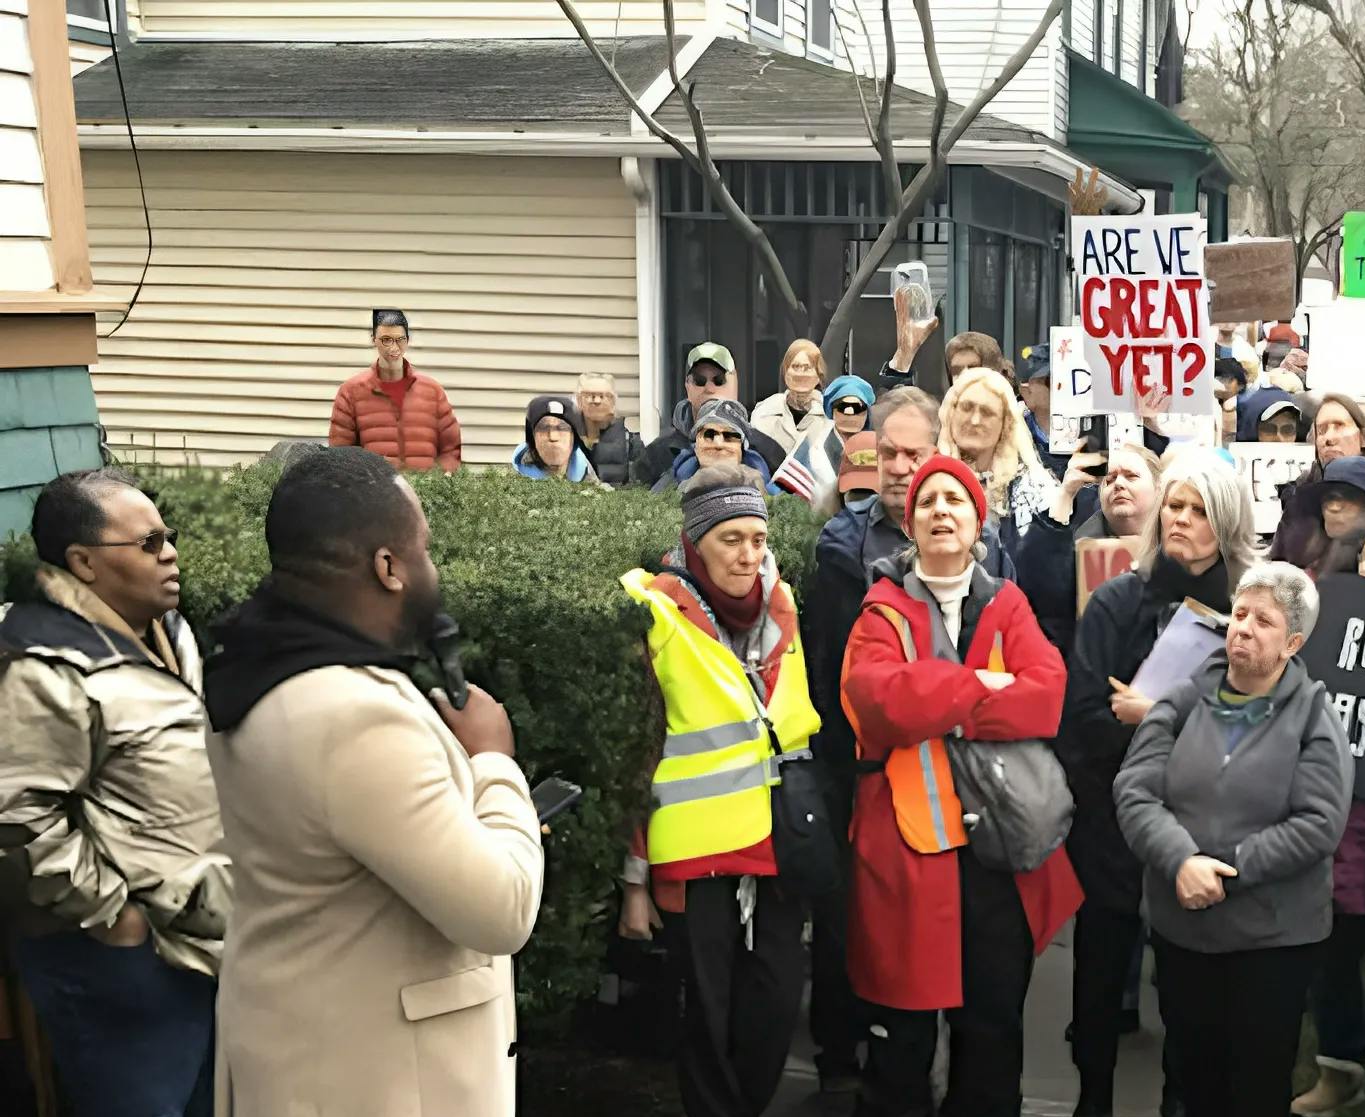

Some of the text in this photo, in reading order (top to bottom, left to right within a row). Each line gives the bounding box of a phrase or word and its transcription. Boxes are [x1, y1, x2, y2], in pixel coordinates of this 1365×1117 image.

[1083, 228, 1146, 275] ARE
[1083, 277, 1202, 339] GREAT
[1099, 342, 1207, 396] YET?
